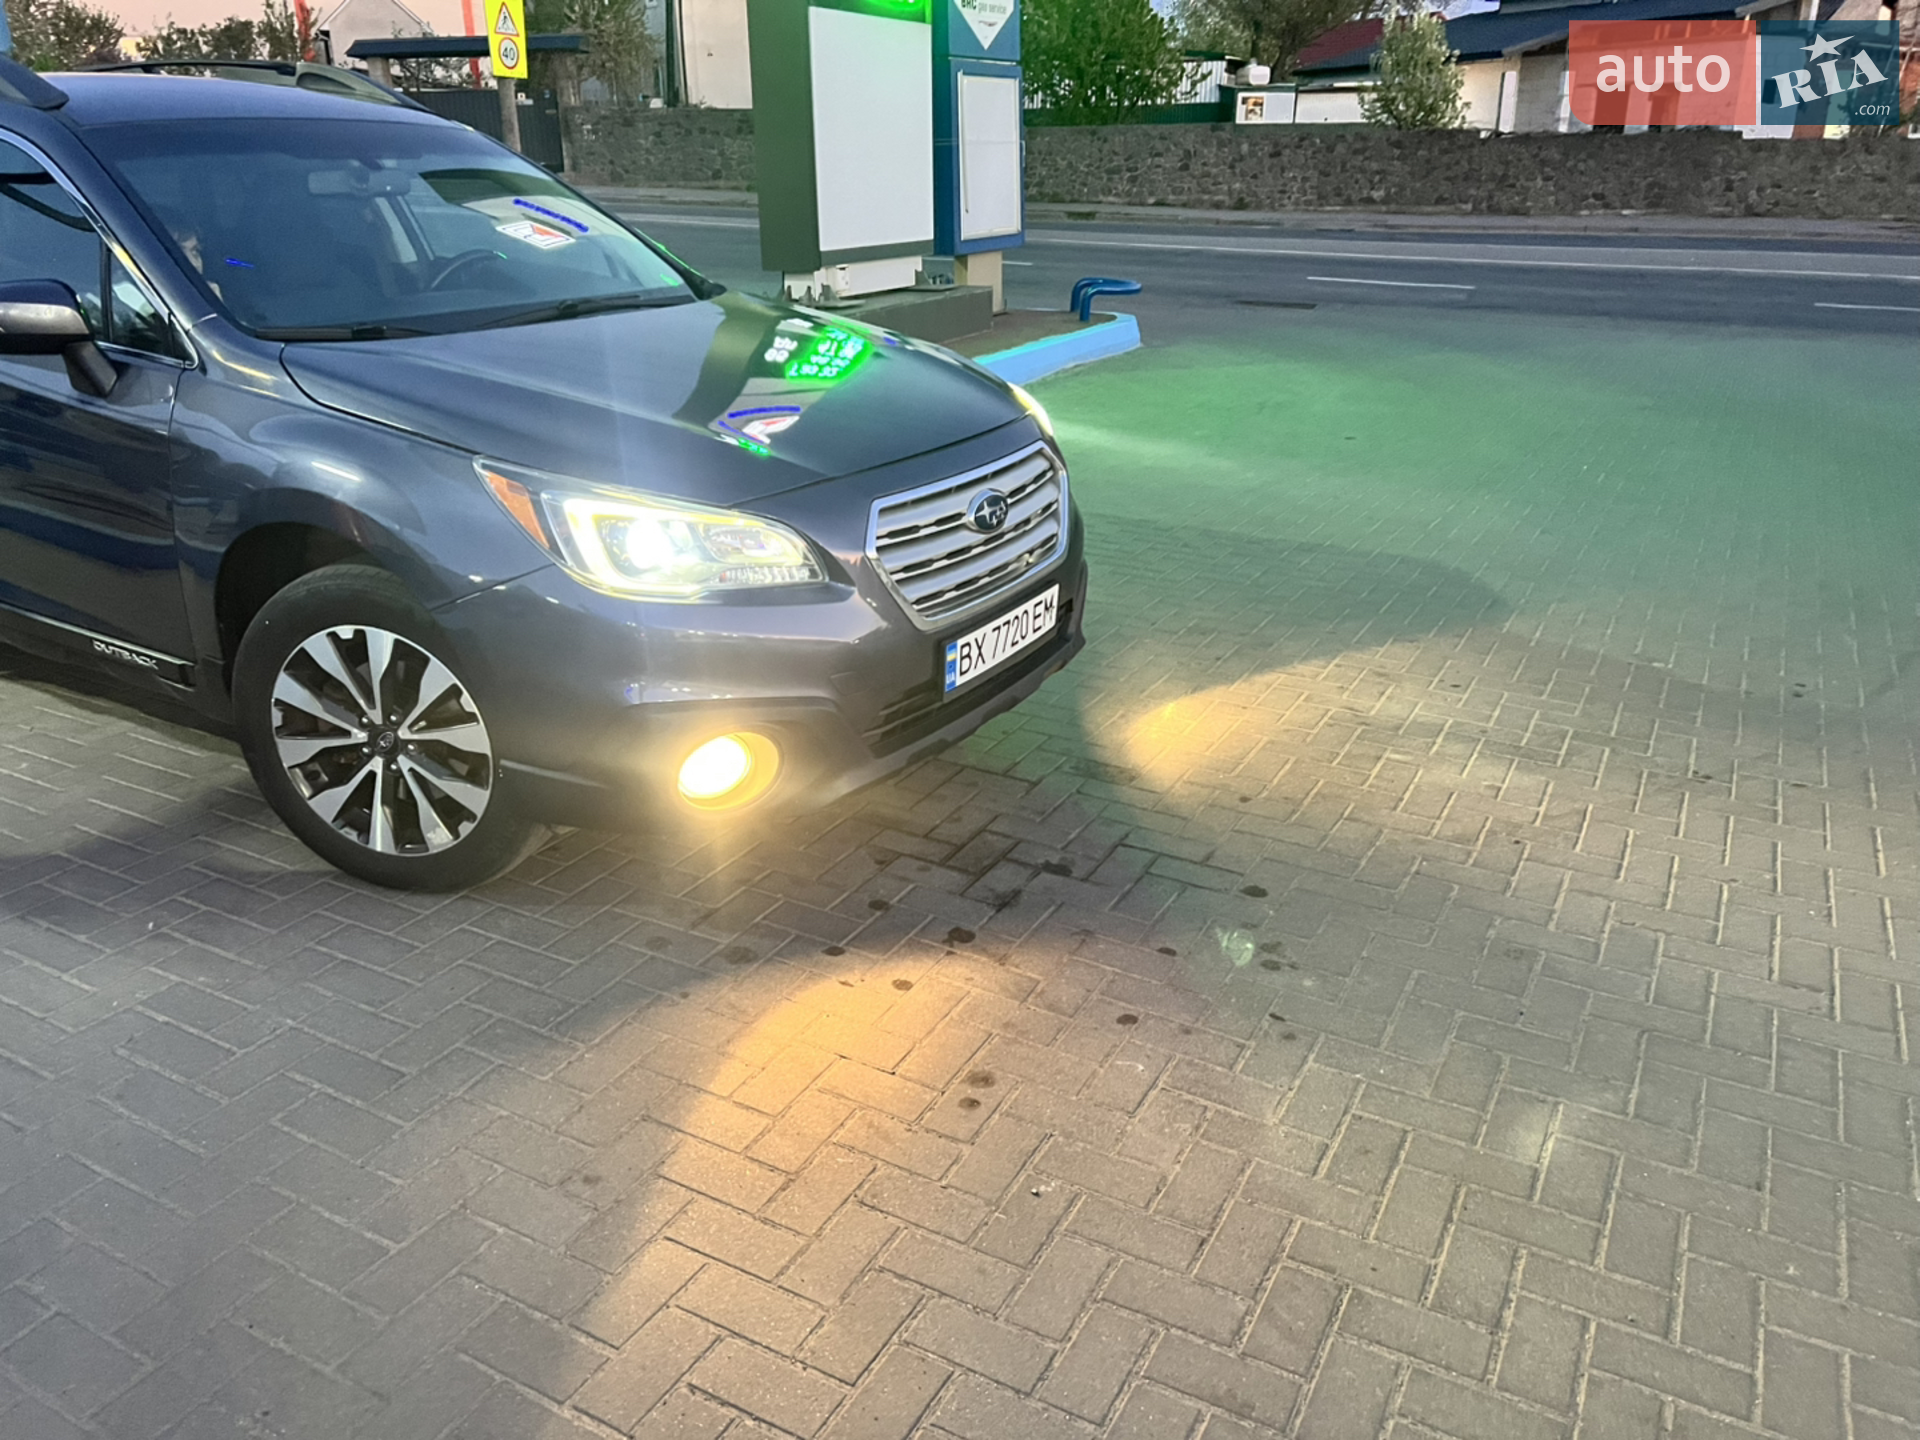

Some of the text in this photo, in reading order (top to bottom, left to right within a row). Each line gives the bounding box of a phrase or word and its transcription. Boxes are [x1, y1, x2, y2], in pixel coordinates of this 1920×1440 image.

[502, 47, 516, 61] 40
[959, 593, 1056, 677] BX 7720 EM
